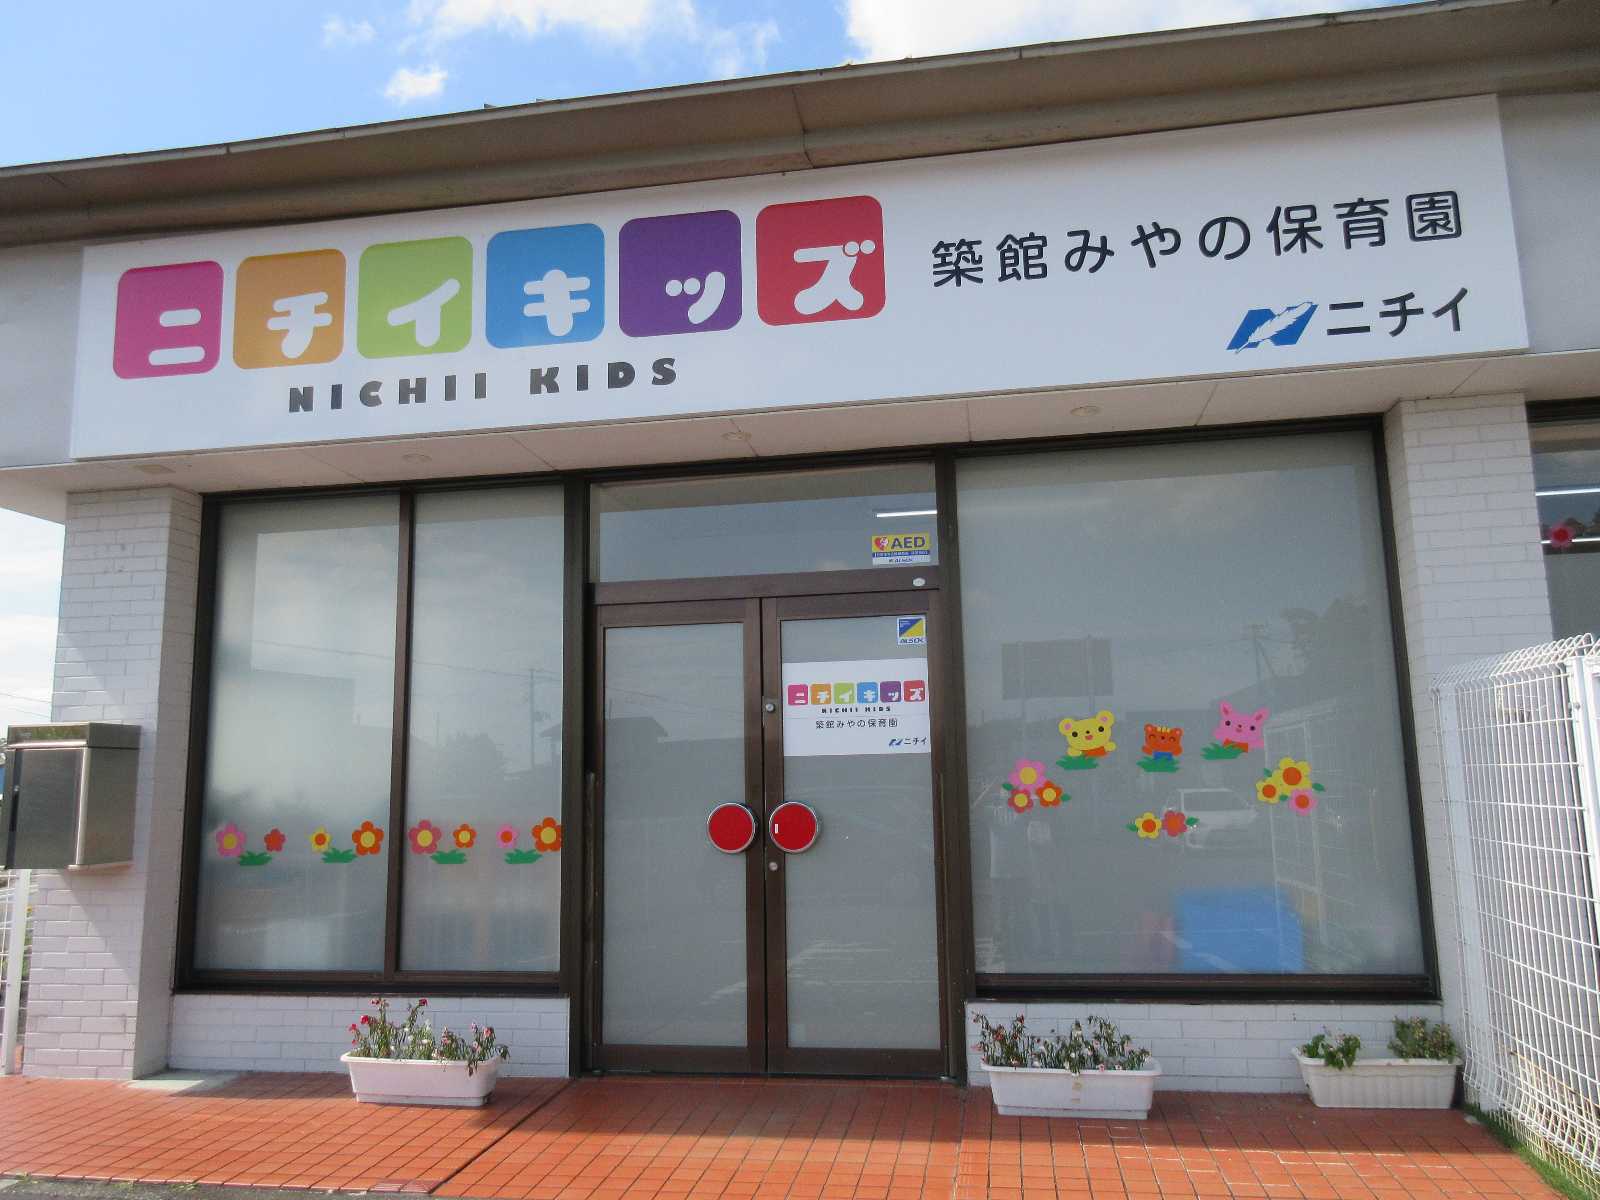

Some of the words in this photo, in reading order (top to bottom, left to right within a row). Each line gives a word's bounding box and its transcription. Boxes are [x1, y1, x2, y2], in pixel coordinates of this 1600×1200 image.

[931, 190, 1463, 288] 築館みやの保育園
[148, 239, 876, 367] ニチイキッズ
[1326, 287, 1469, 337] ニチイ
[288, 372, 487, 413] NICHII
[529, 357, 678, 395] KIDS
[890, 536, 926, 549] AED
[794, 687, 924, 704] ニチイキッズ
[903, 737, 927, 746] ニチイ
